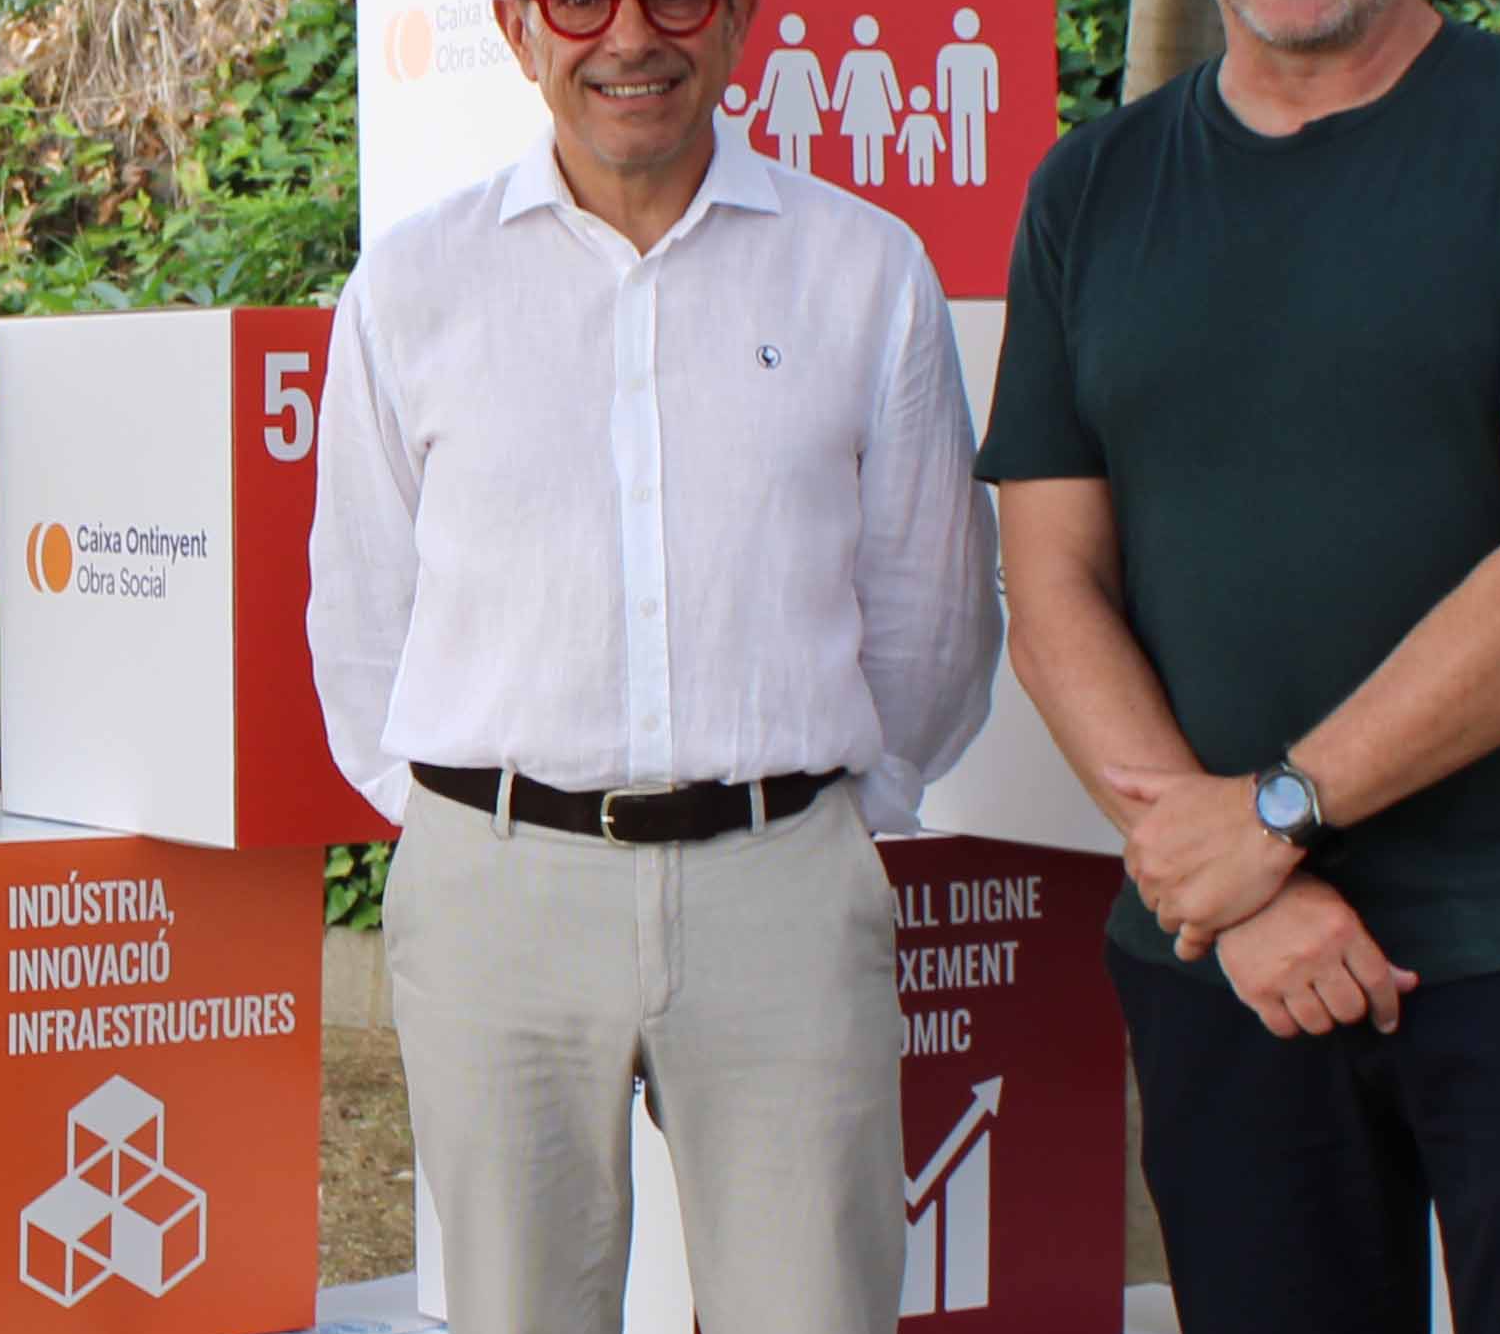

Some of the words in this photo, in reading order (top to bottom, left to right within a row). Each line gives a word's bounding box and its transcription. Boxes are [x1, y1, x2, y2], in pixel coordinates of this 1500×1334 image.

[264, 352, 314, 461] 5
[77, 523, 121, 553] Caixa
[126, 526, 207, 564] Ontinyent
[77, 564, 115, 594] Obra
[120, 567, 166, 598] Social
[8, 871, 175, 929] INDÚSTRIA,
[950, 876, 1043, 925] DIGNE
[8, 929, 171, 992] INNOVACIÓ
[899, 941, 1019, 994] XEMENT
[8, 992, 296, 1056] INFRAESTRUCTURES
